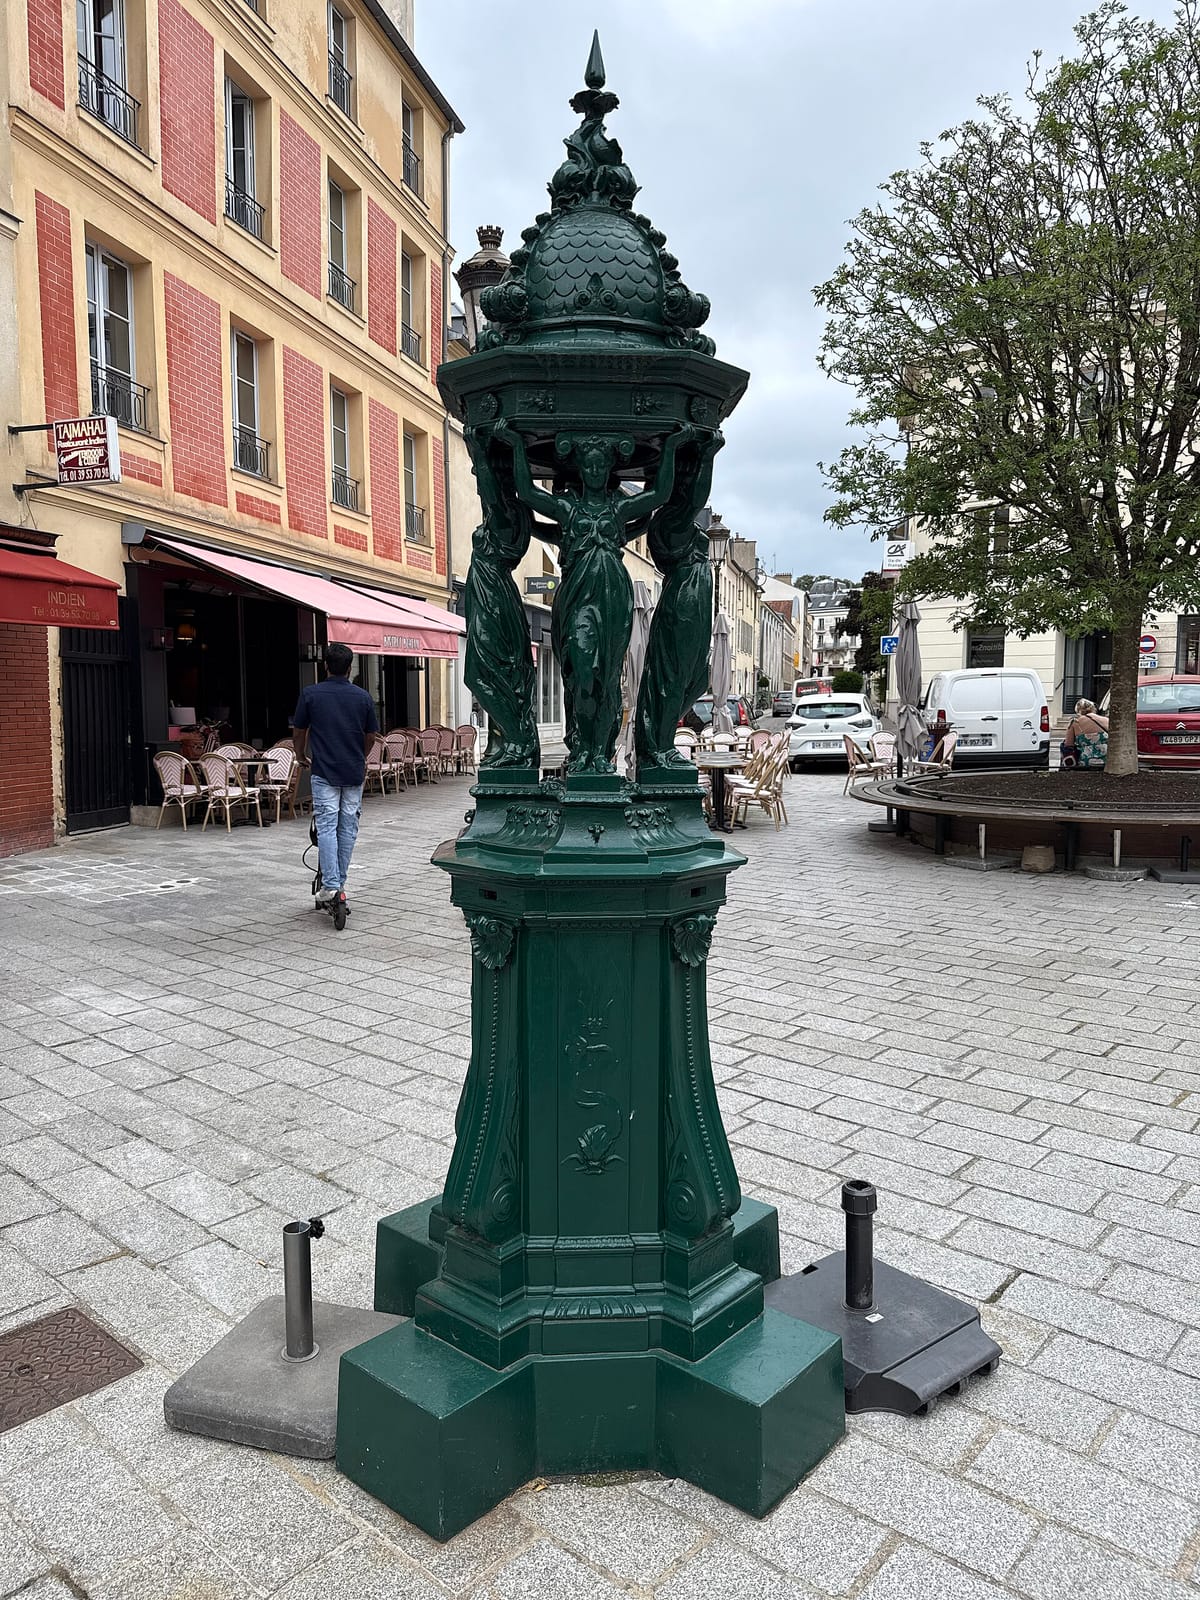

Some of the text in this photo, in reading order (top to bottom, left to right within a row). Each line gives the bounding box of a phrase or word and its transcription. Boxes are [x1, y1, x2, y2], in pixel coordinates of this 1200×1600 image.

[58, 437, 106, 448] Restaurant Indien
[70, 470, 77, 480] 01
[78, 469, 85, 480] 39
[86, 469, 93, 479] 53
[94, 468, 101, 479] 70
[47, 591, 86, 607] INDIEN
[50, 608, 59, 617] 01
[60, 609, 69, 618] 39
[82, 610, 90, 620] 70
